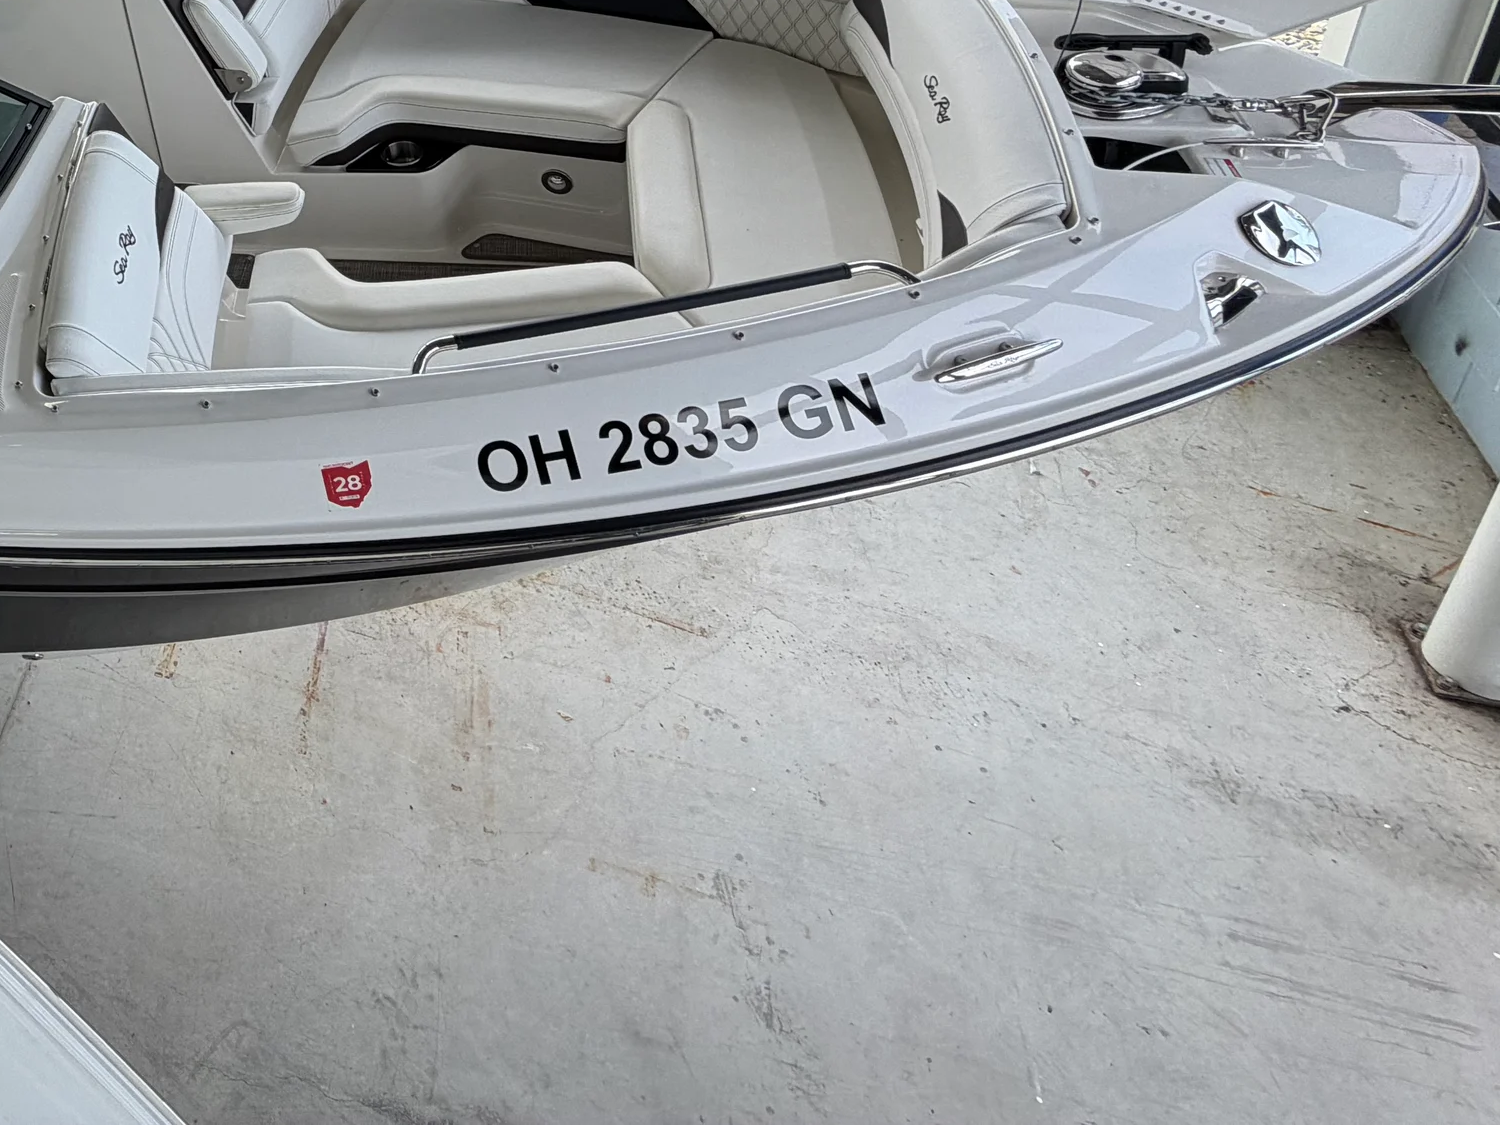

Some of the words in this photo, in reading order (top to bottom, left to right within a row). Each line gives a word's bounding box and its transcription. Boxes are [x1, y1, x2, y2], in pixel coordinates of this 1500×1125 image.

[923, 75, 939, 101] Sea
[934, 96, 951, 124] Ray
[477, 430, 582, 492] OH
[599, 397, 758, 474] 2835
[778, 373, 887, 439] GN
[333, 475, 362, 493] 28
